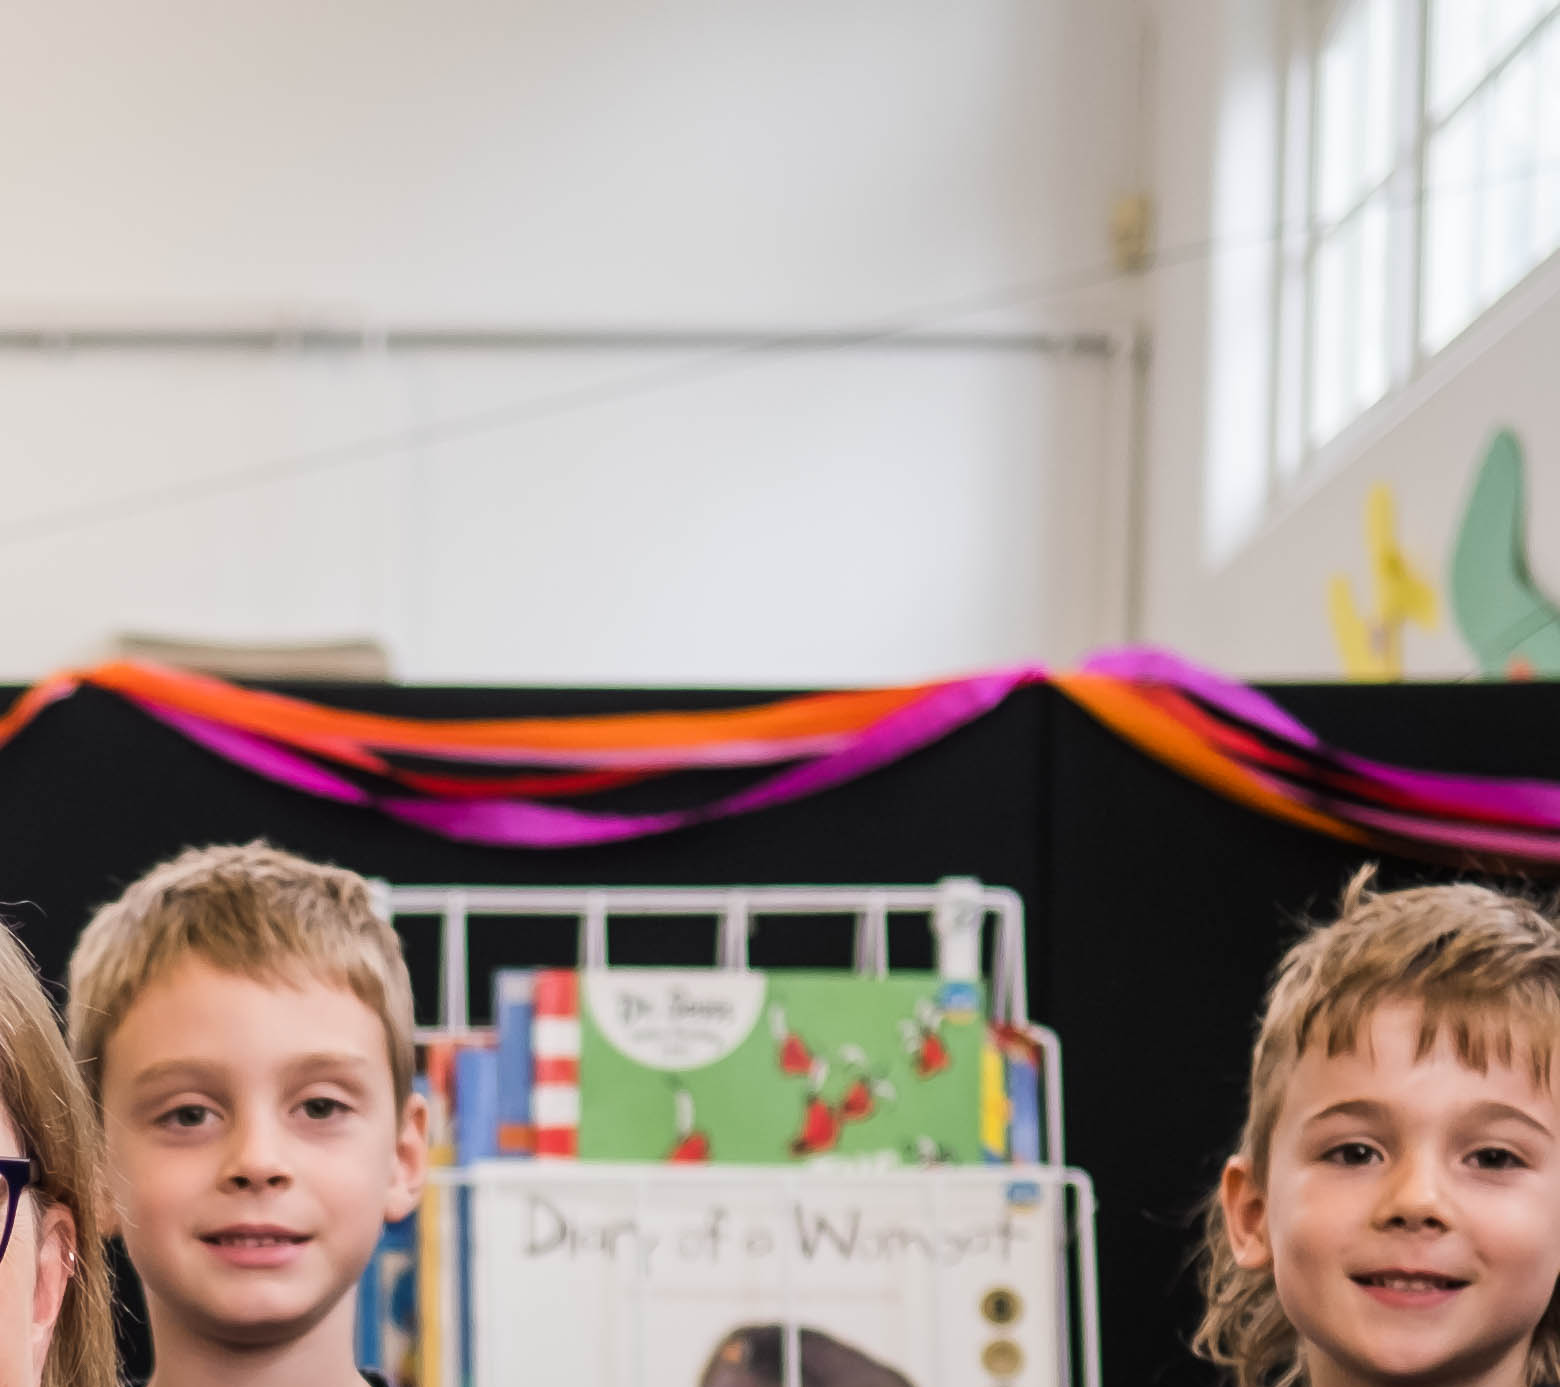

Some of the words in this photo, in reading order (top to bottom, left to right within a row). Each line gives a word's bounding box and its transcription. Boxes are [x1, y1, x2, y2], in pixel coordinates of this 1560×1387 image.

[522, 1198, 659, 1277] Diary
[679, 1206, 730, 1261] of
[745, 1224, 778, 1258] a
